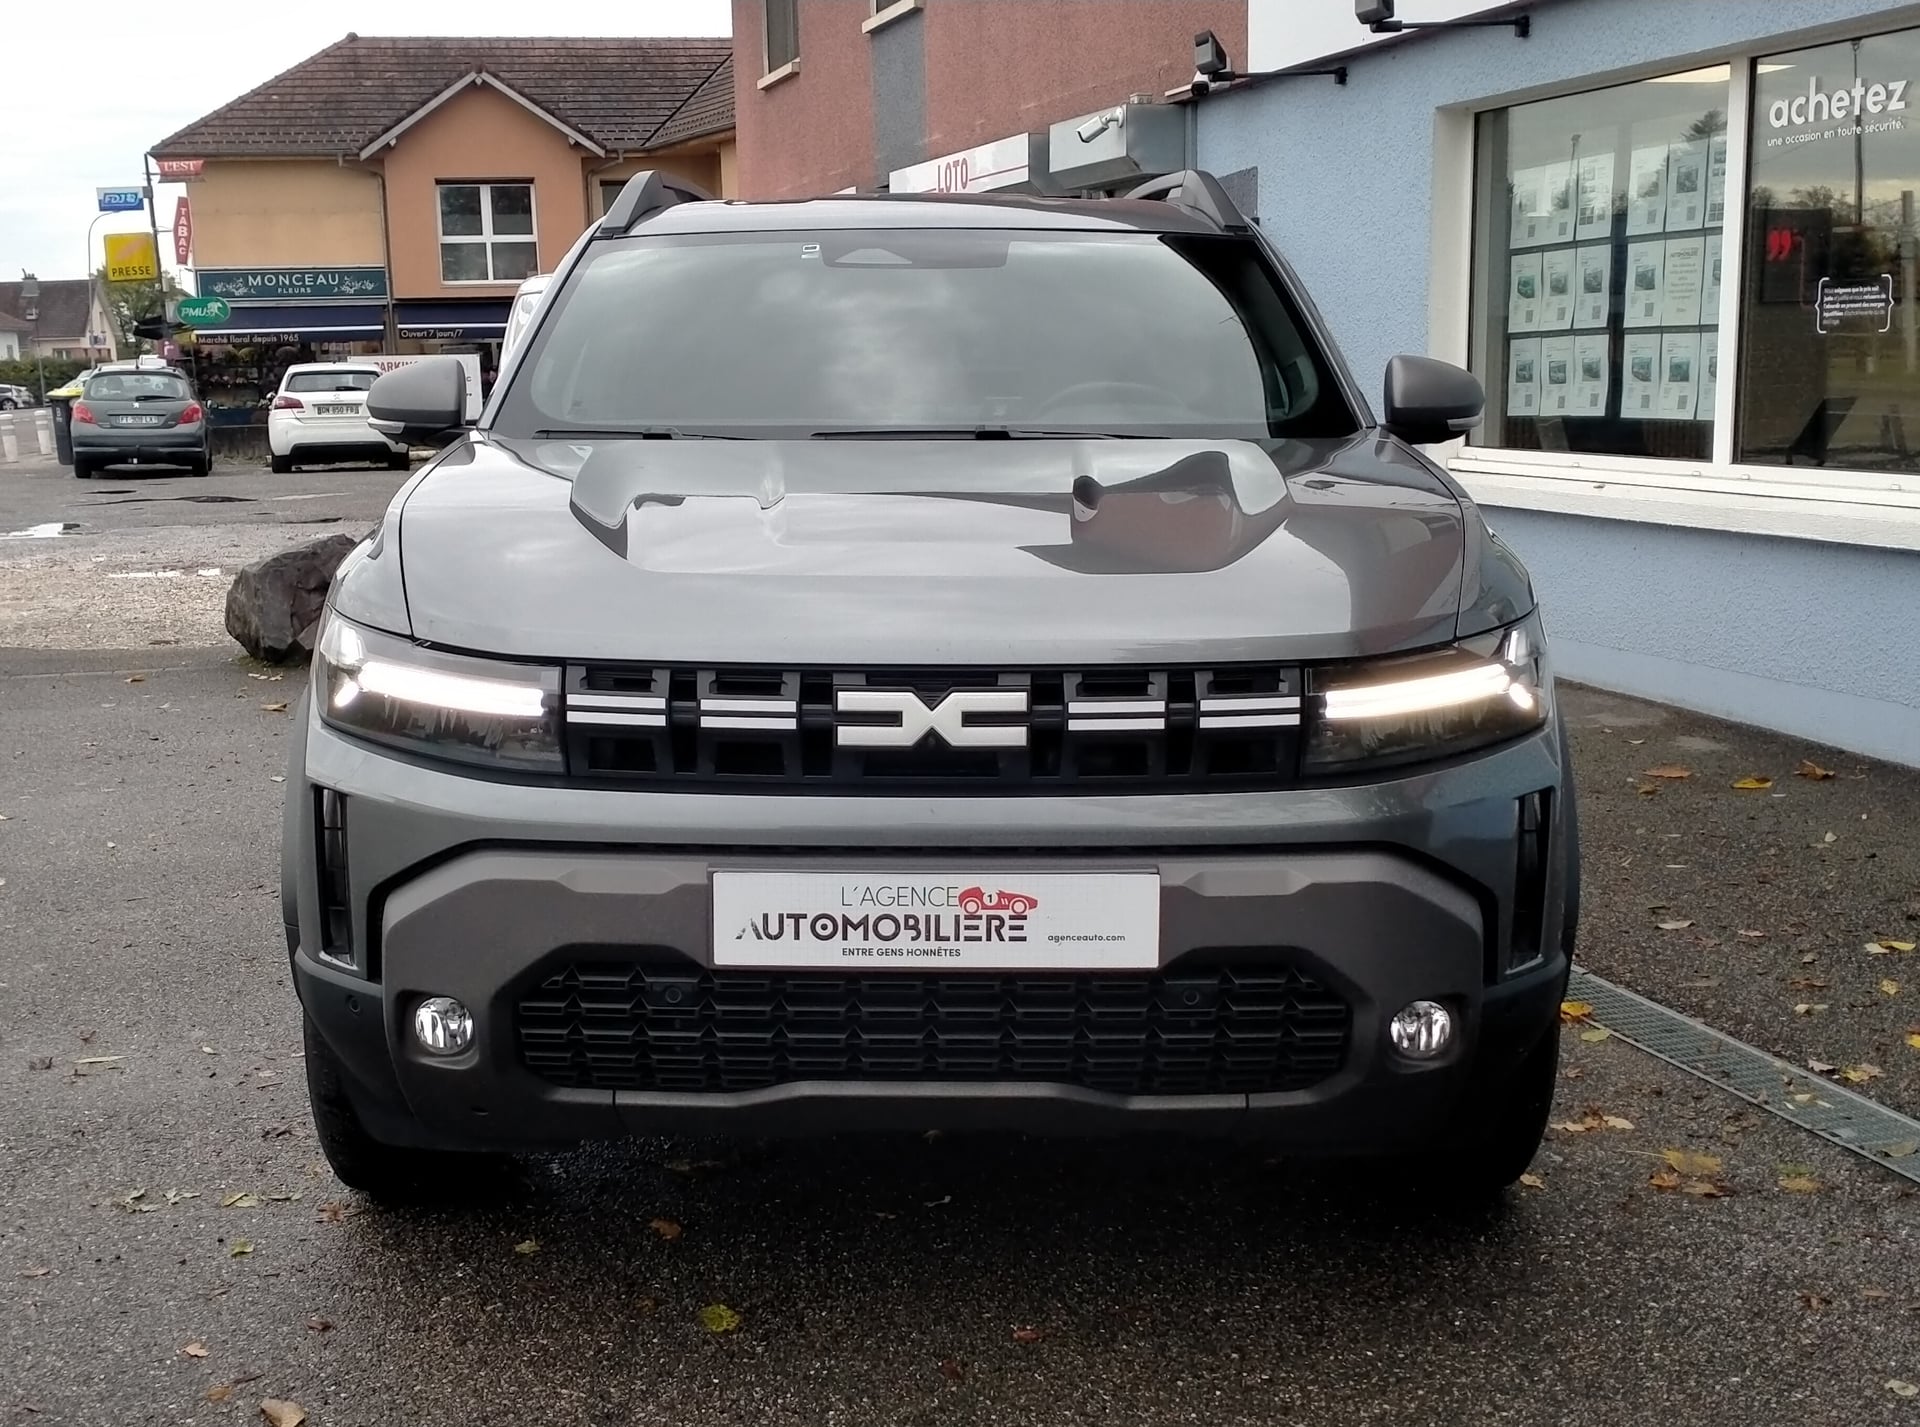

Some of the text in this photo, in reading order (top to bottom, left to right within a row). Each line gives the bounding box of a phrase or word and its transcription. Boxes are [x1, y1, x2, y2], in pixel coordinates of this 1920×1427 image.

[1769, 76, 1908, 128] achetez
[1767, 116, 1905, 147] une occasion en toute sécurité.
[937, 157, 968, 193] LOTO
[104, 194, 127, 204] FDJ
[177, 208, 188, 255] TABAC
[111, 265, 152, 277] PRESSE
[248, 273, 340, 287] MONCEAU
[181, 307, 207, 317] PMU
[198, 333, 299, 345] Marché floral depuis 1965
[400, 329, 427, 338] Ouvert
[428, 329, 434, 337] 7
[841, 886, 960, 907] L'AGENCE
[1047, 933, 1126, 944] agenceauto.com
[842, 946, 961, 957] ENTRE GENS HONNÊTES
